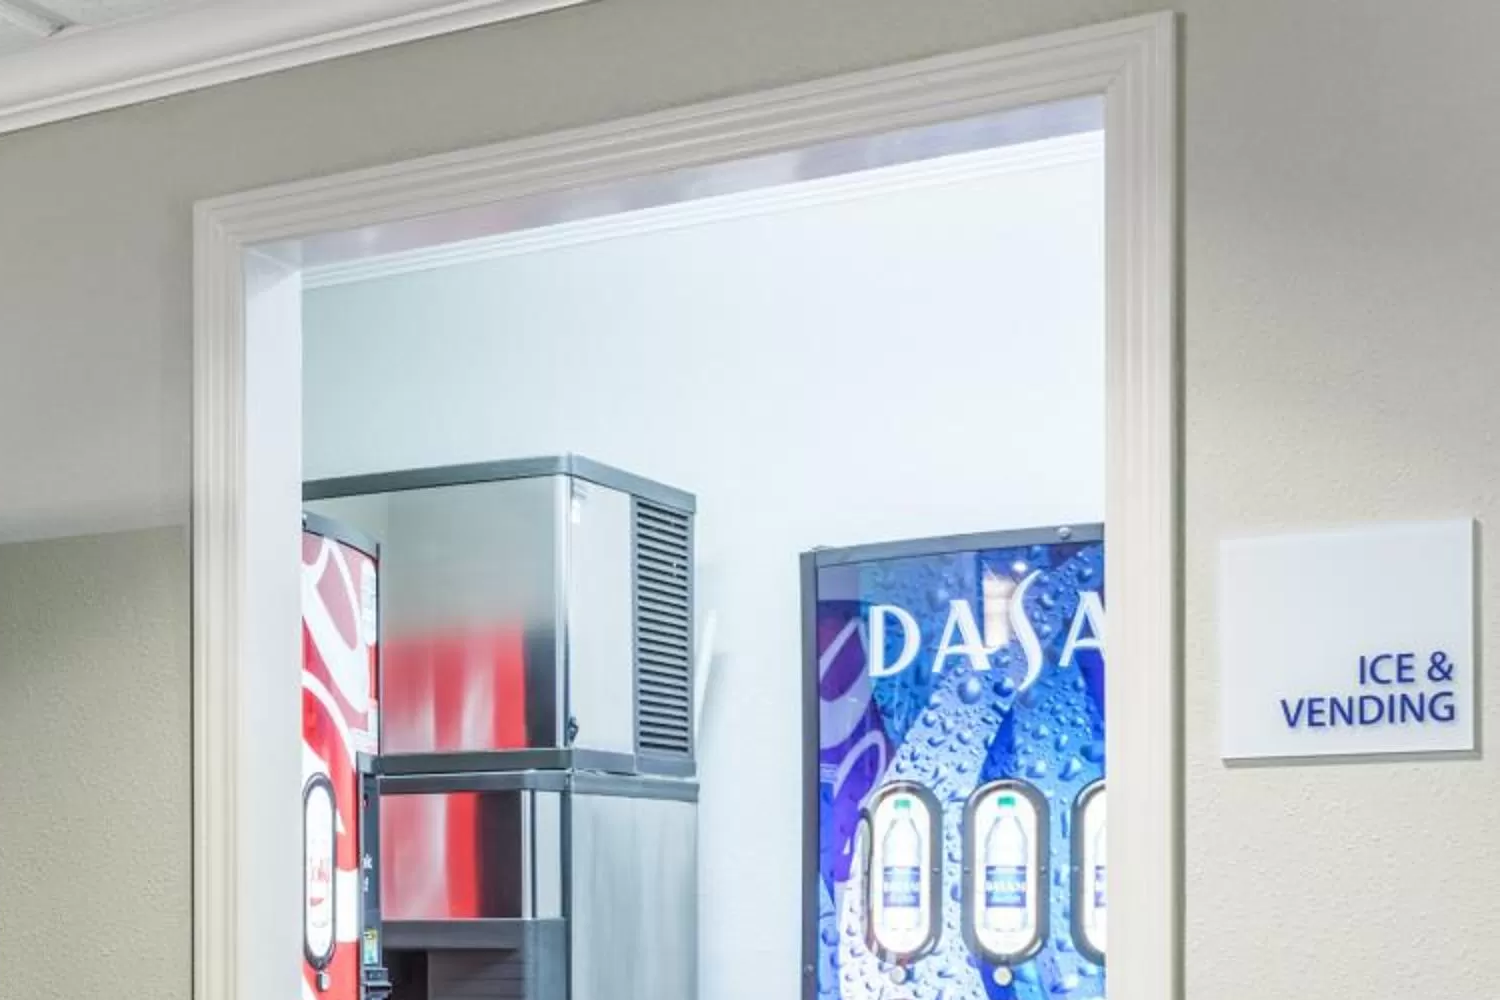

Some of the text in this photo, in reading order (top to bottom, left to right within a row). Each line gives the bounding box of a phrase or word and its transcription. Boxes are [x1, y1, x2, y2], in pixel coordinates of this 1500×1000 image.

[1359, 651, 1453, 685] ICE &
[1280, 691, 1456, 728] VENDING
